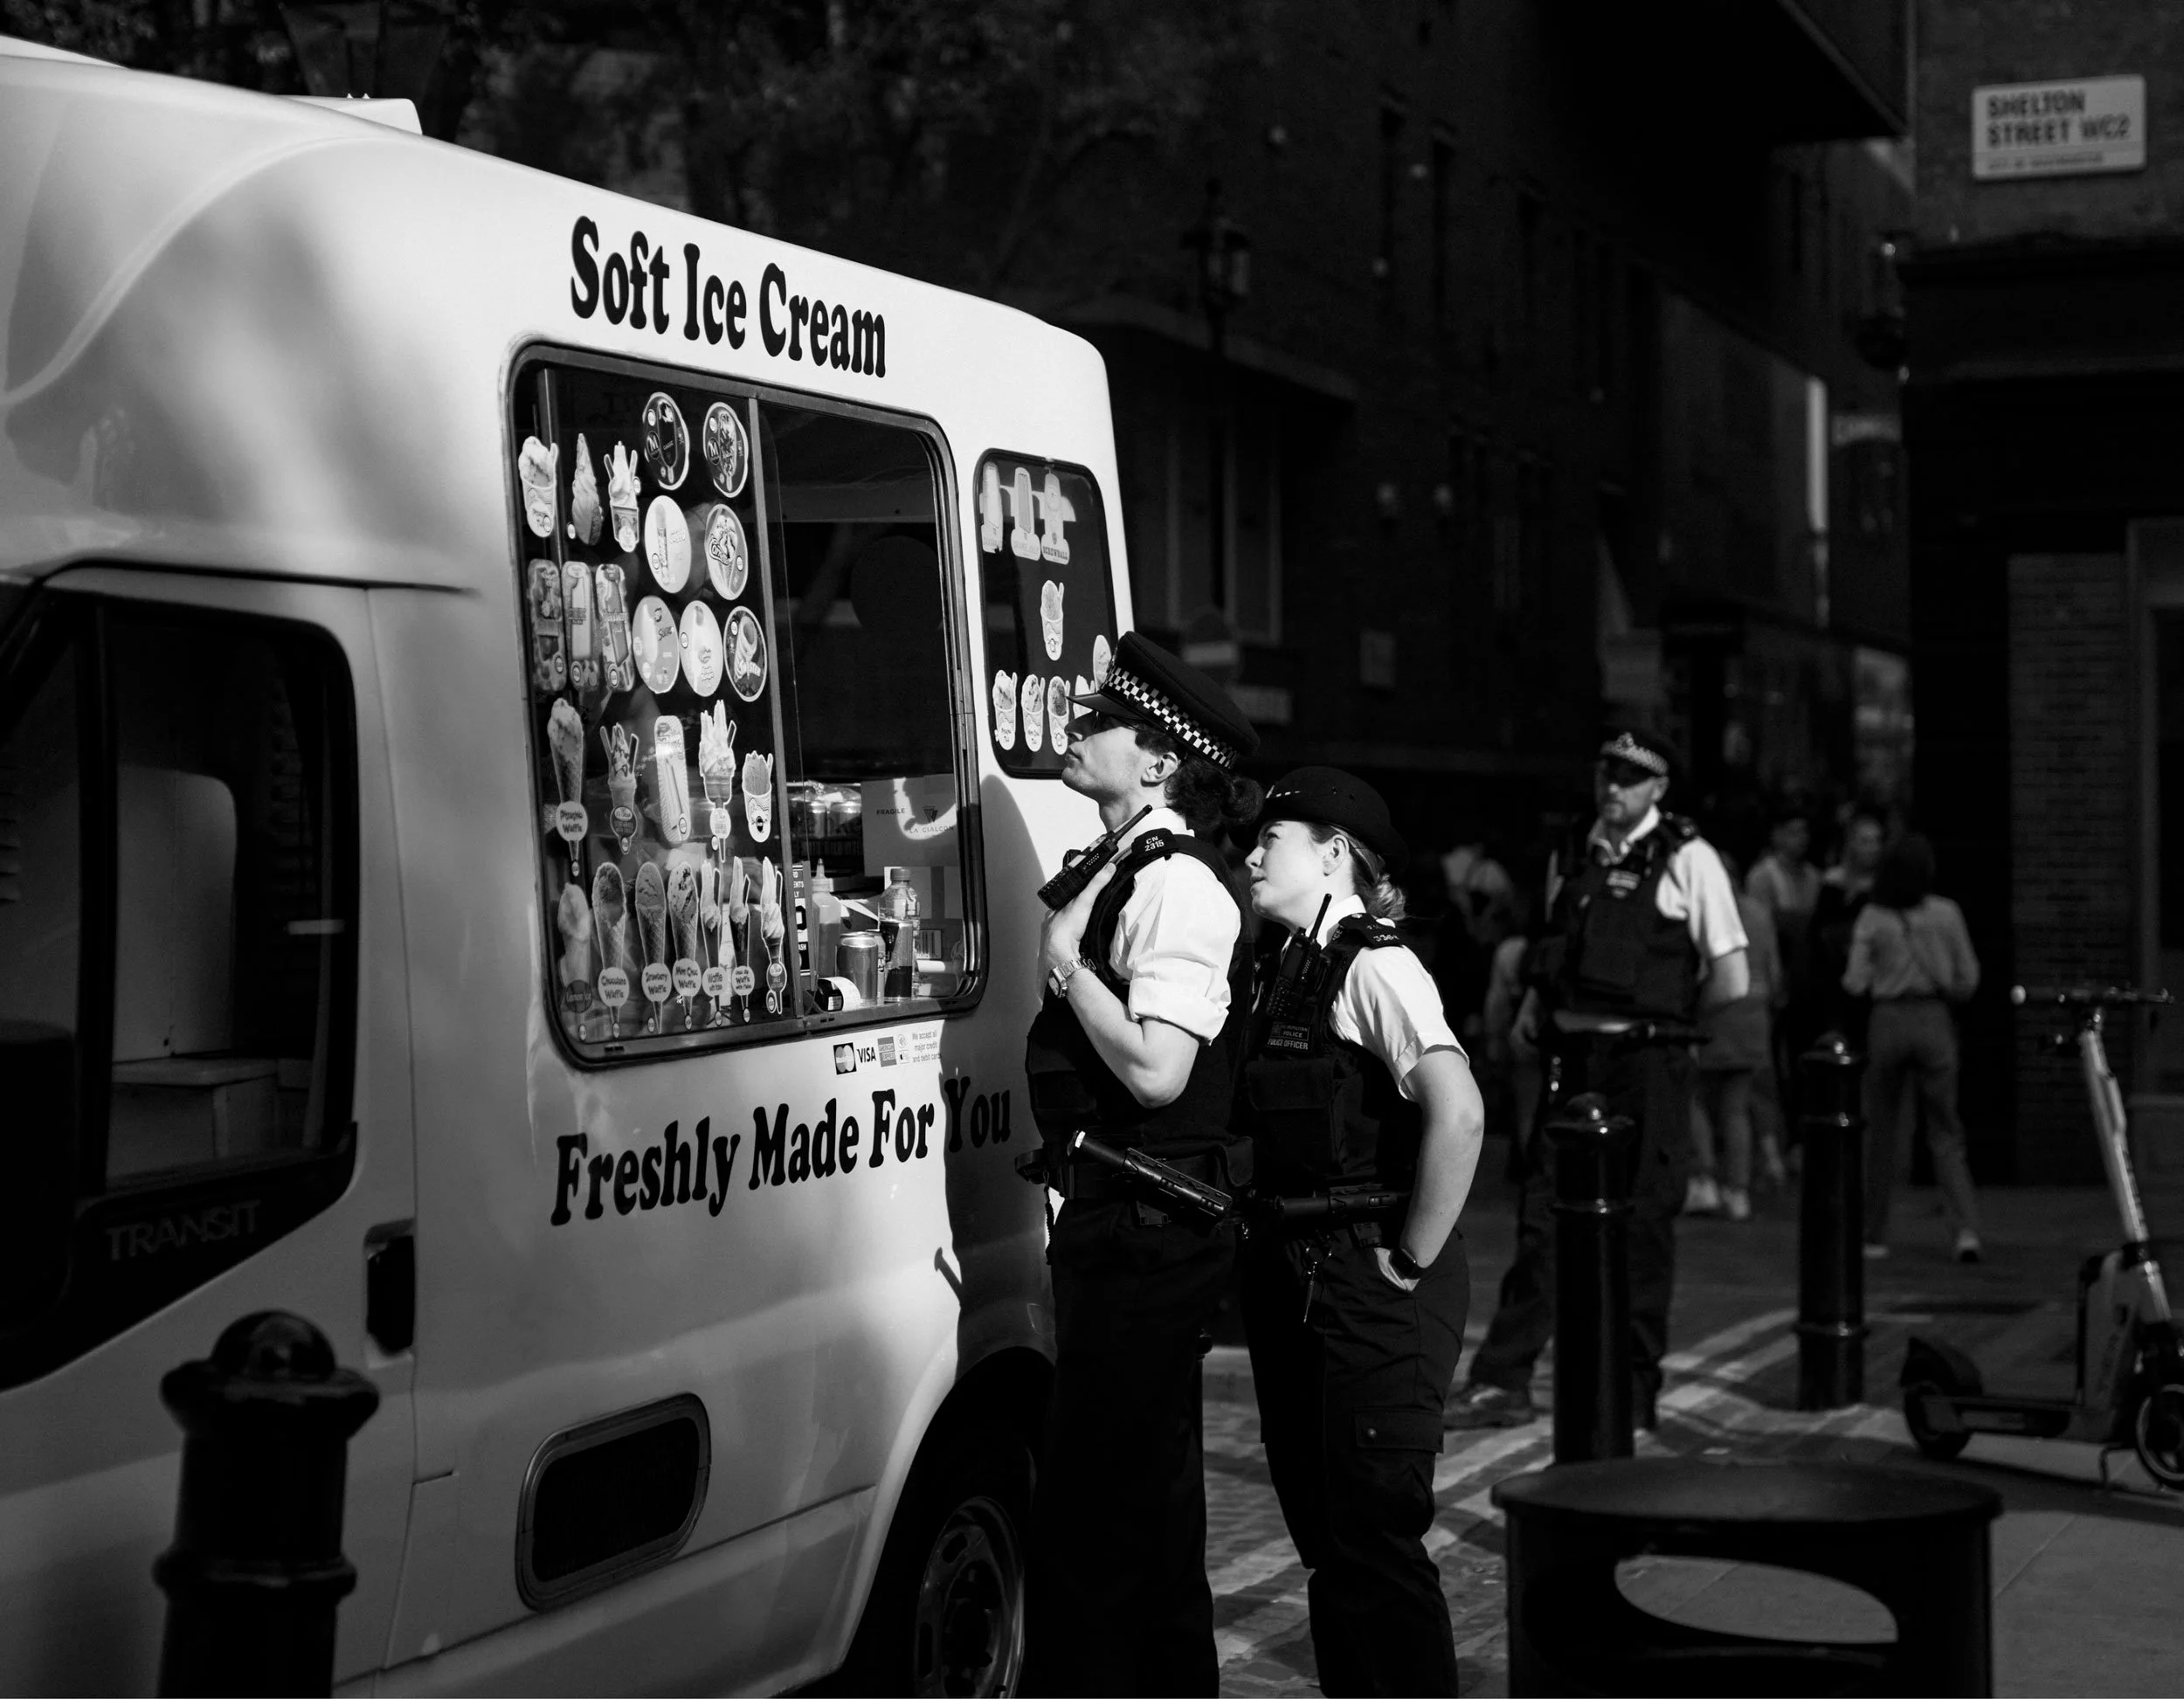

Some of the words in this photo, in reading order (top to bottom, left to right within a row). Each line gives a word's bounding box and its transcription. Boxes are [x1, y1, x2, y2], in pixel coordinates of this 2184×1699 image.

[1987, 89, 2085, 119] SHELTON
[1987, 118, 2070, 149] STREET
[2079, 113, 2131, 142] WC2
[570, 216, 670, 335] Soft
[683, 243, 747, 350] Ice
[759, 262, 886, 378] Cream
[1144, 839, 1165, 852] 2315
[1145, 835, 1159, 845] CN
[857, 1046, 876, 1063] VISA
[1267, 1038, 1283, 1046] POLICE
[1283, 1039, 1309, 1051] OFFICER
[550, 1116, 740, 1226] Freshly
[749, 1098, 860, 1190] Made
[869, 1088, 934, 1168] For
[944, 1077, 1011, 1153] You
[105, 1198, 261, 1261] TRANSIT
